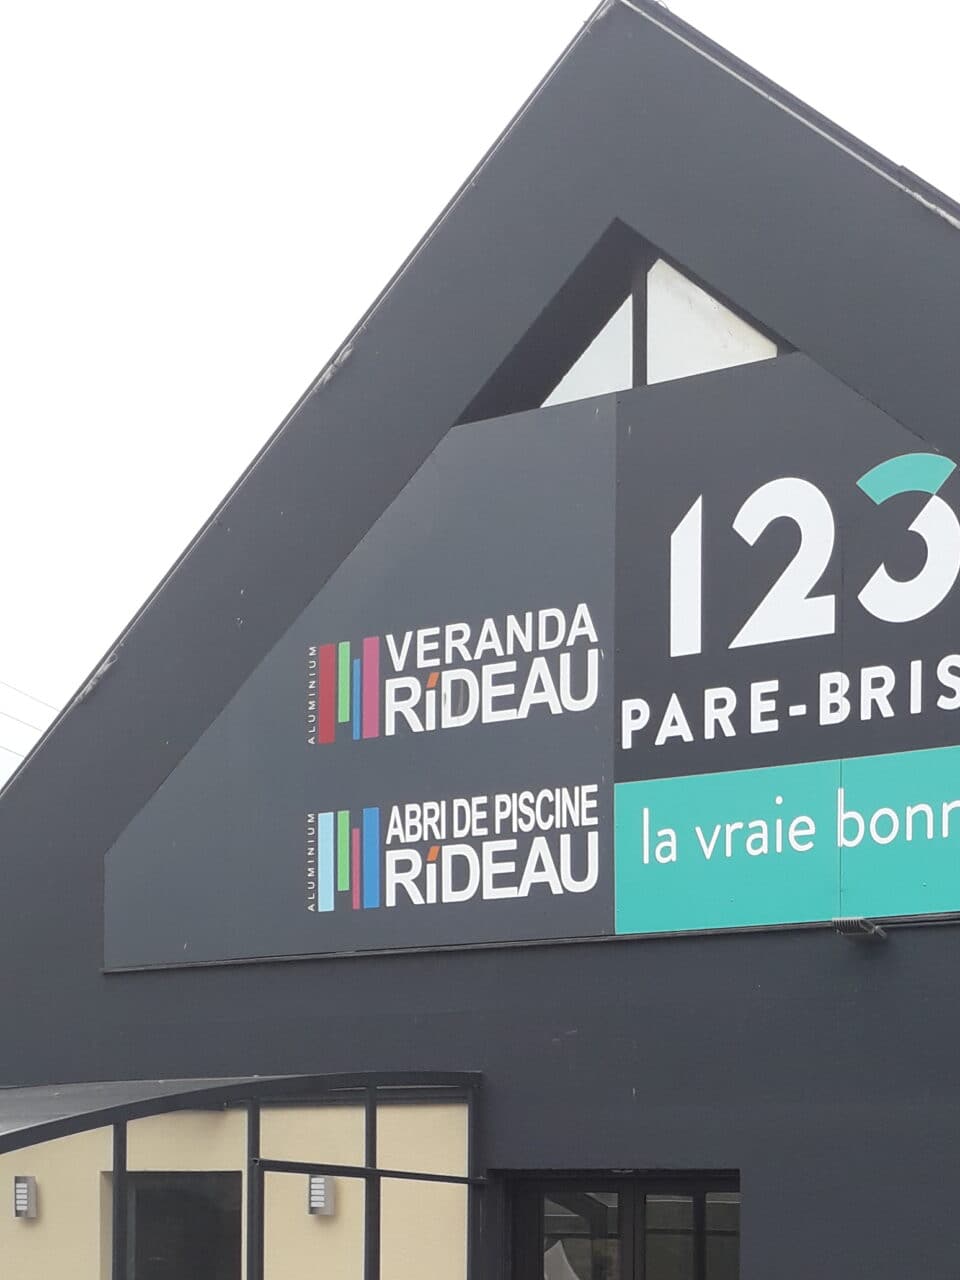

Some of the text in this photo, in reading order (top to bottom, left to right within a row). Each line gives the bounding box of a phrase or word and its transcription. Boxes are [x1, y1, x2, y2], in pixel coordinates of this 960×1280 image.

[385, 603, 599, 672] VERANDA
[307, 646, 317, 745] ALUMINIUM
[385, 783, 599, 845] ABRI DE PISCINE
[642, 807, 678, 865] la
[694, 796, 817, 858] vraie
[307, 812, 316, 912] ALUMINIUM
